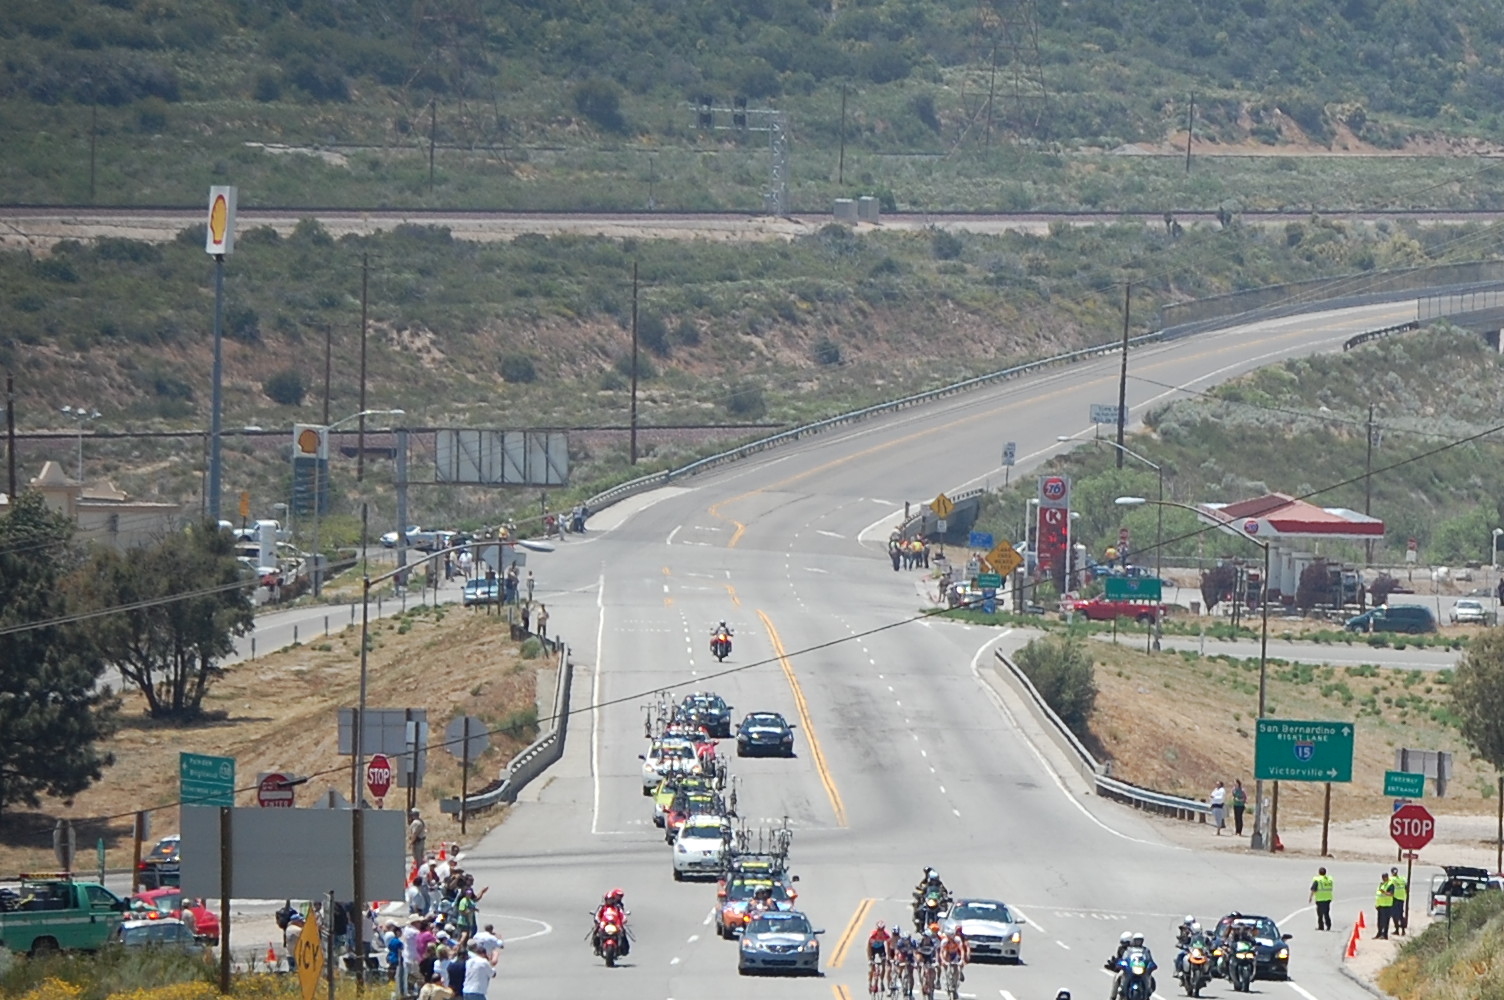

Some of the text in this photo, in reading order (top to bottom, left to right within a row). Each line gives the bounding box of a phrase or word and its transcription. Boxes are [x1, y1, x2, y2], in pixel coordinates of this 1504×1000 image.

[1047, 482, 1061, 494] 76
[1260, 724, 1336, 735] San Bernardino
[1298, 747, 1311, 758] 15
[368, 767, 390, 785] STOP
[1268, 767, 1323, 777] Victorville
[1392, 818, 1432, 837] STOP
[298, 940, 320, 972] ICY
